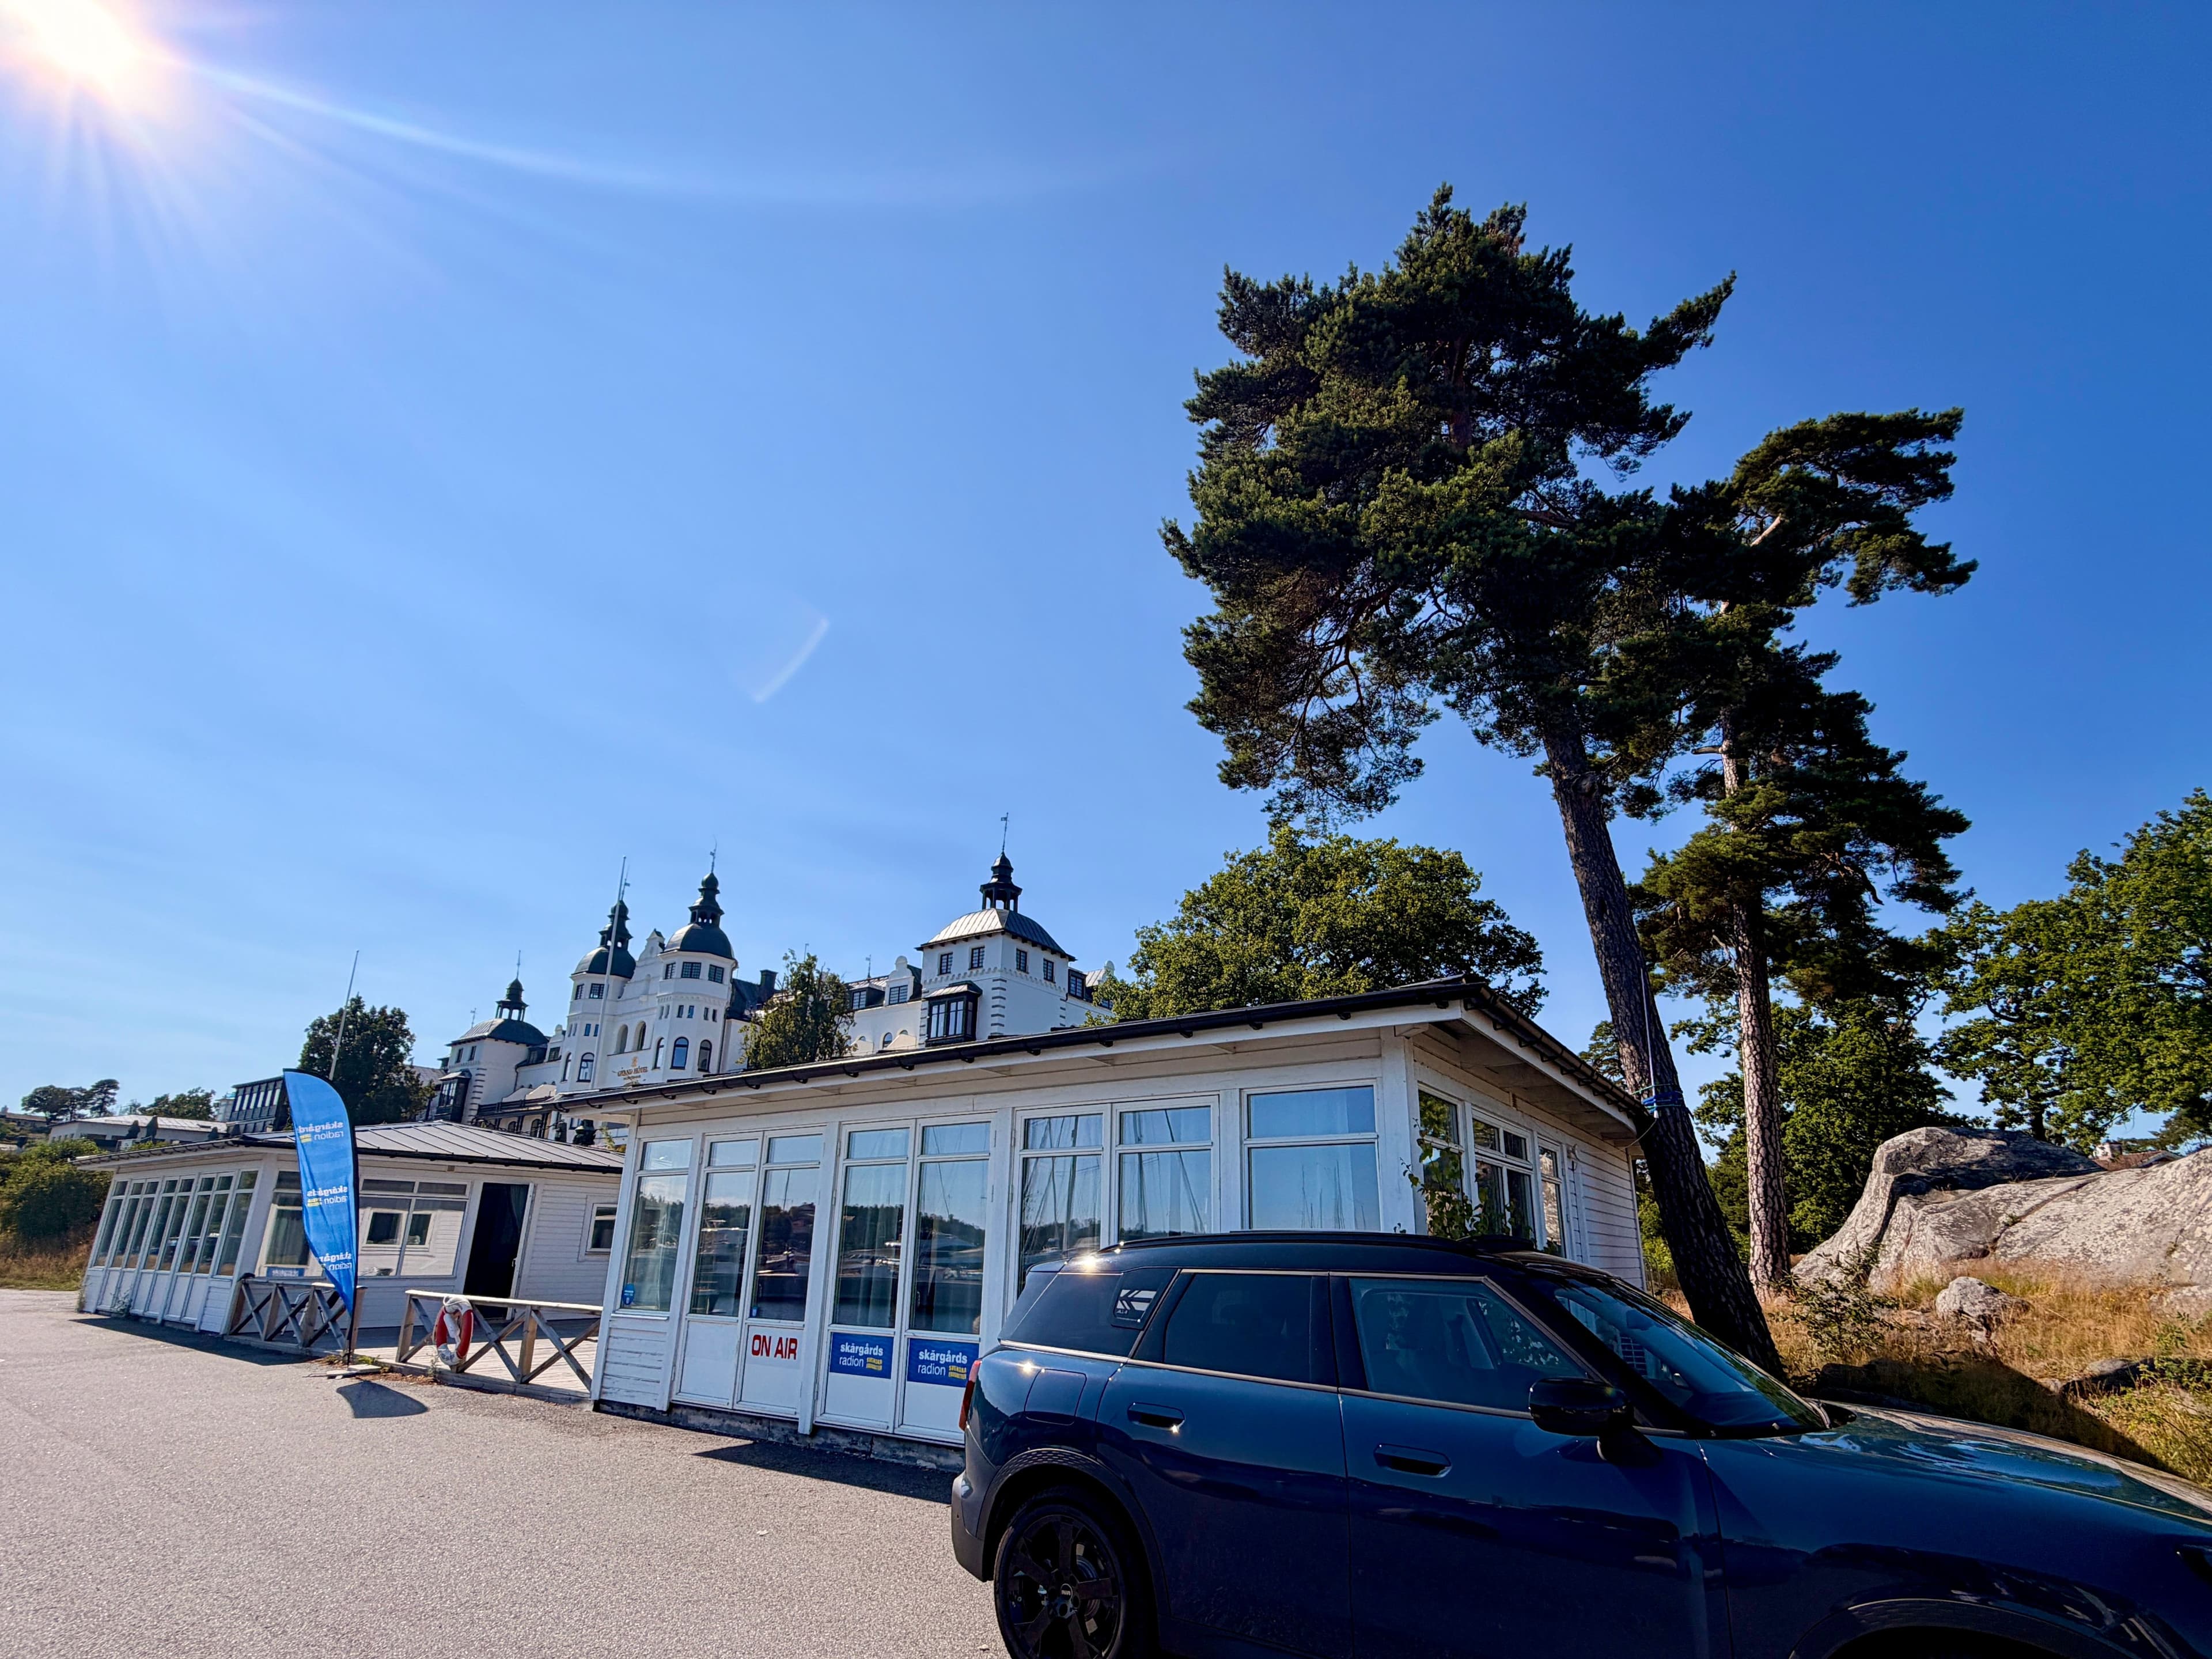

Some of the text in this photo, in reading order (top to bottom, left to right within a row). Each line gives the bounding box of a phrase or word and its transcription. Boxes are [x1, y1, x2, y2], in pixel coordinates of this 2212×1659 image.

[752, 1334, 798, 1360] ON AIR
[840, 1342, 883, 1356] skärgårds
[839, 1355, 864, 1368] radion
[918, 1349, 968, 1364] skärgårds
[918, 1363, 946, 1376] radion
